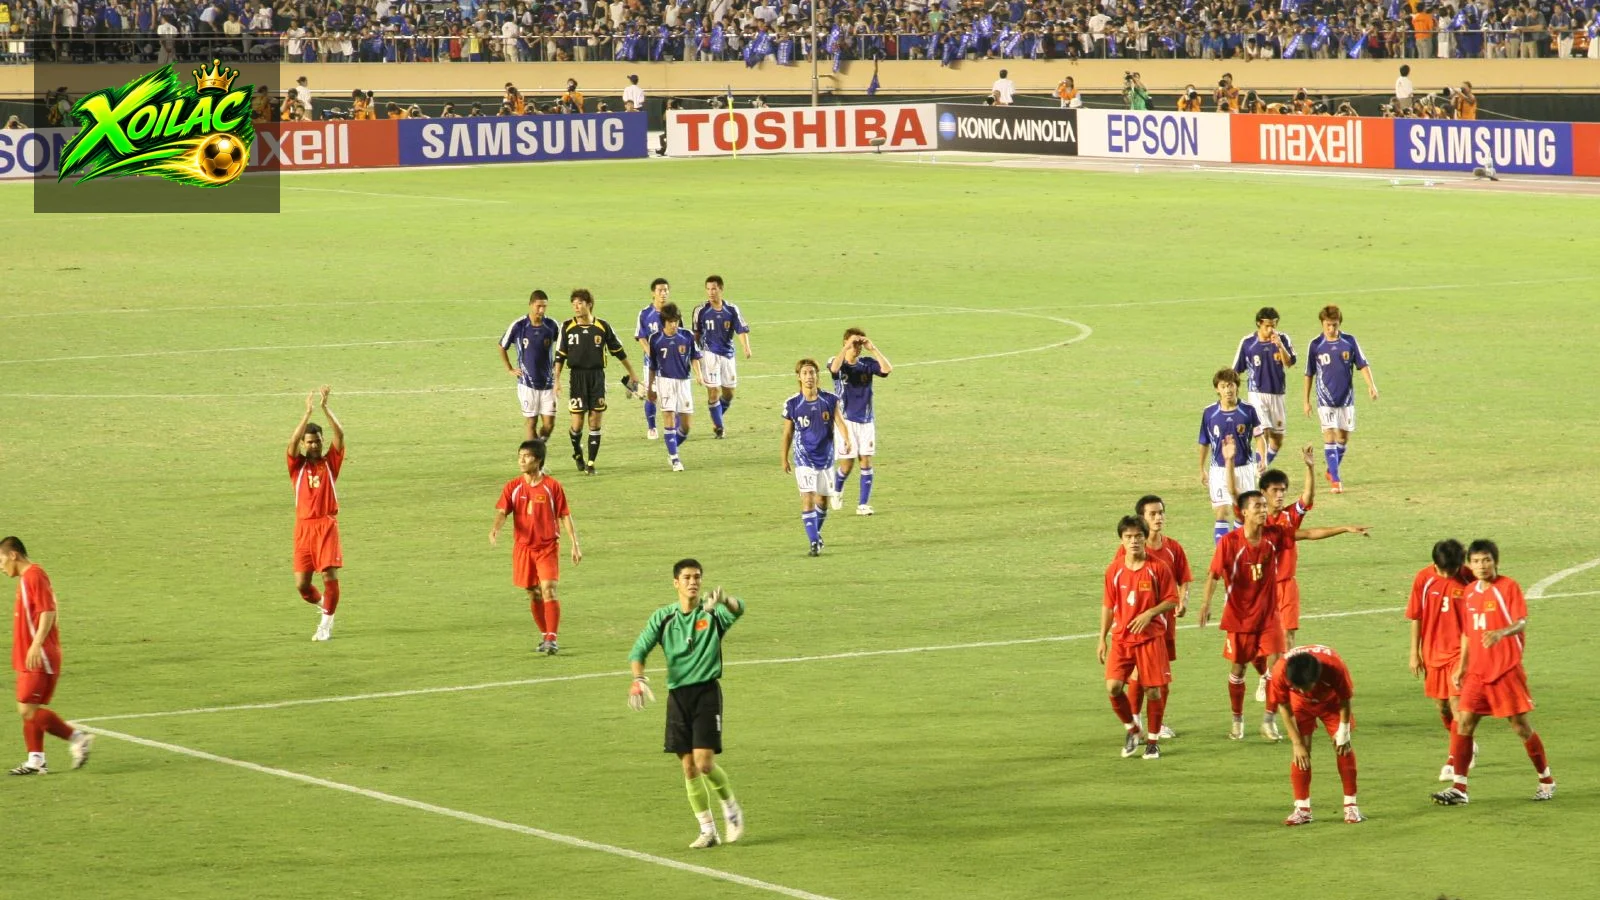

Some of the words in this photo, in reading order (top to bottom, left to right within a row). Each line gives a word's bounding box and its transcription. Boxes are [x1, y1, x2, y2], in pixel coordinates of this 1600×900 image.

[676, 107, 927, 152] TOSHIBA
[957, 116, 1012, 141] KONICA
[1012, 118, 1076, 143] MINOLTA
[1107, 114, 1199, 156] EPSON
[421, 117, 625, 159] SAMSUNG
[1259, 119, 1363, 165] maxell
[1409, 123, 1557, 168] SAMSUNG
[705, 319, 715, 331] 11
[522, 337, 530, 349] 9
[567, 333, 580, 345] 21
[660, 347, 668, 359] 7
[1317, 353, 1331, 366] 10
[1253, 355, 1262, 367] 8
[570, 397, 583, 409] 21
[797, 415, 811, 429] 16
[1441, 595, 1450, 612] 3
[1473, 612, 1487, 631] 14
